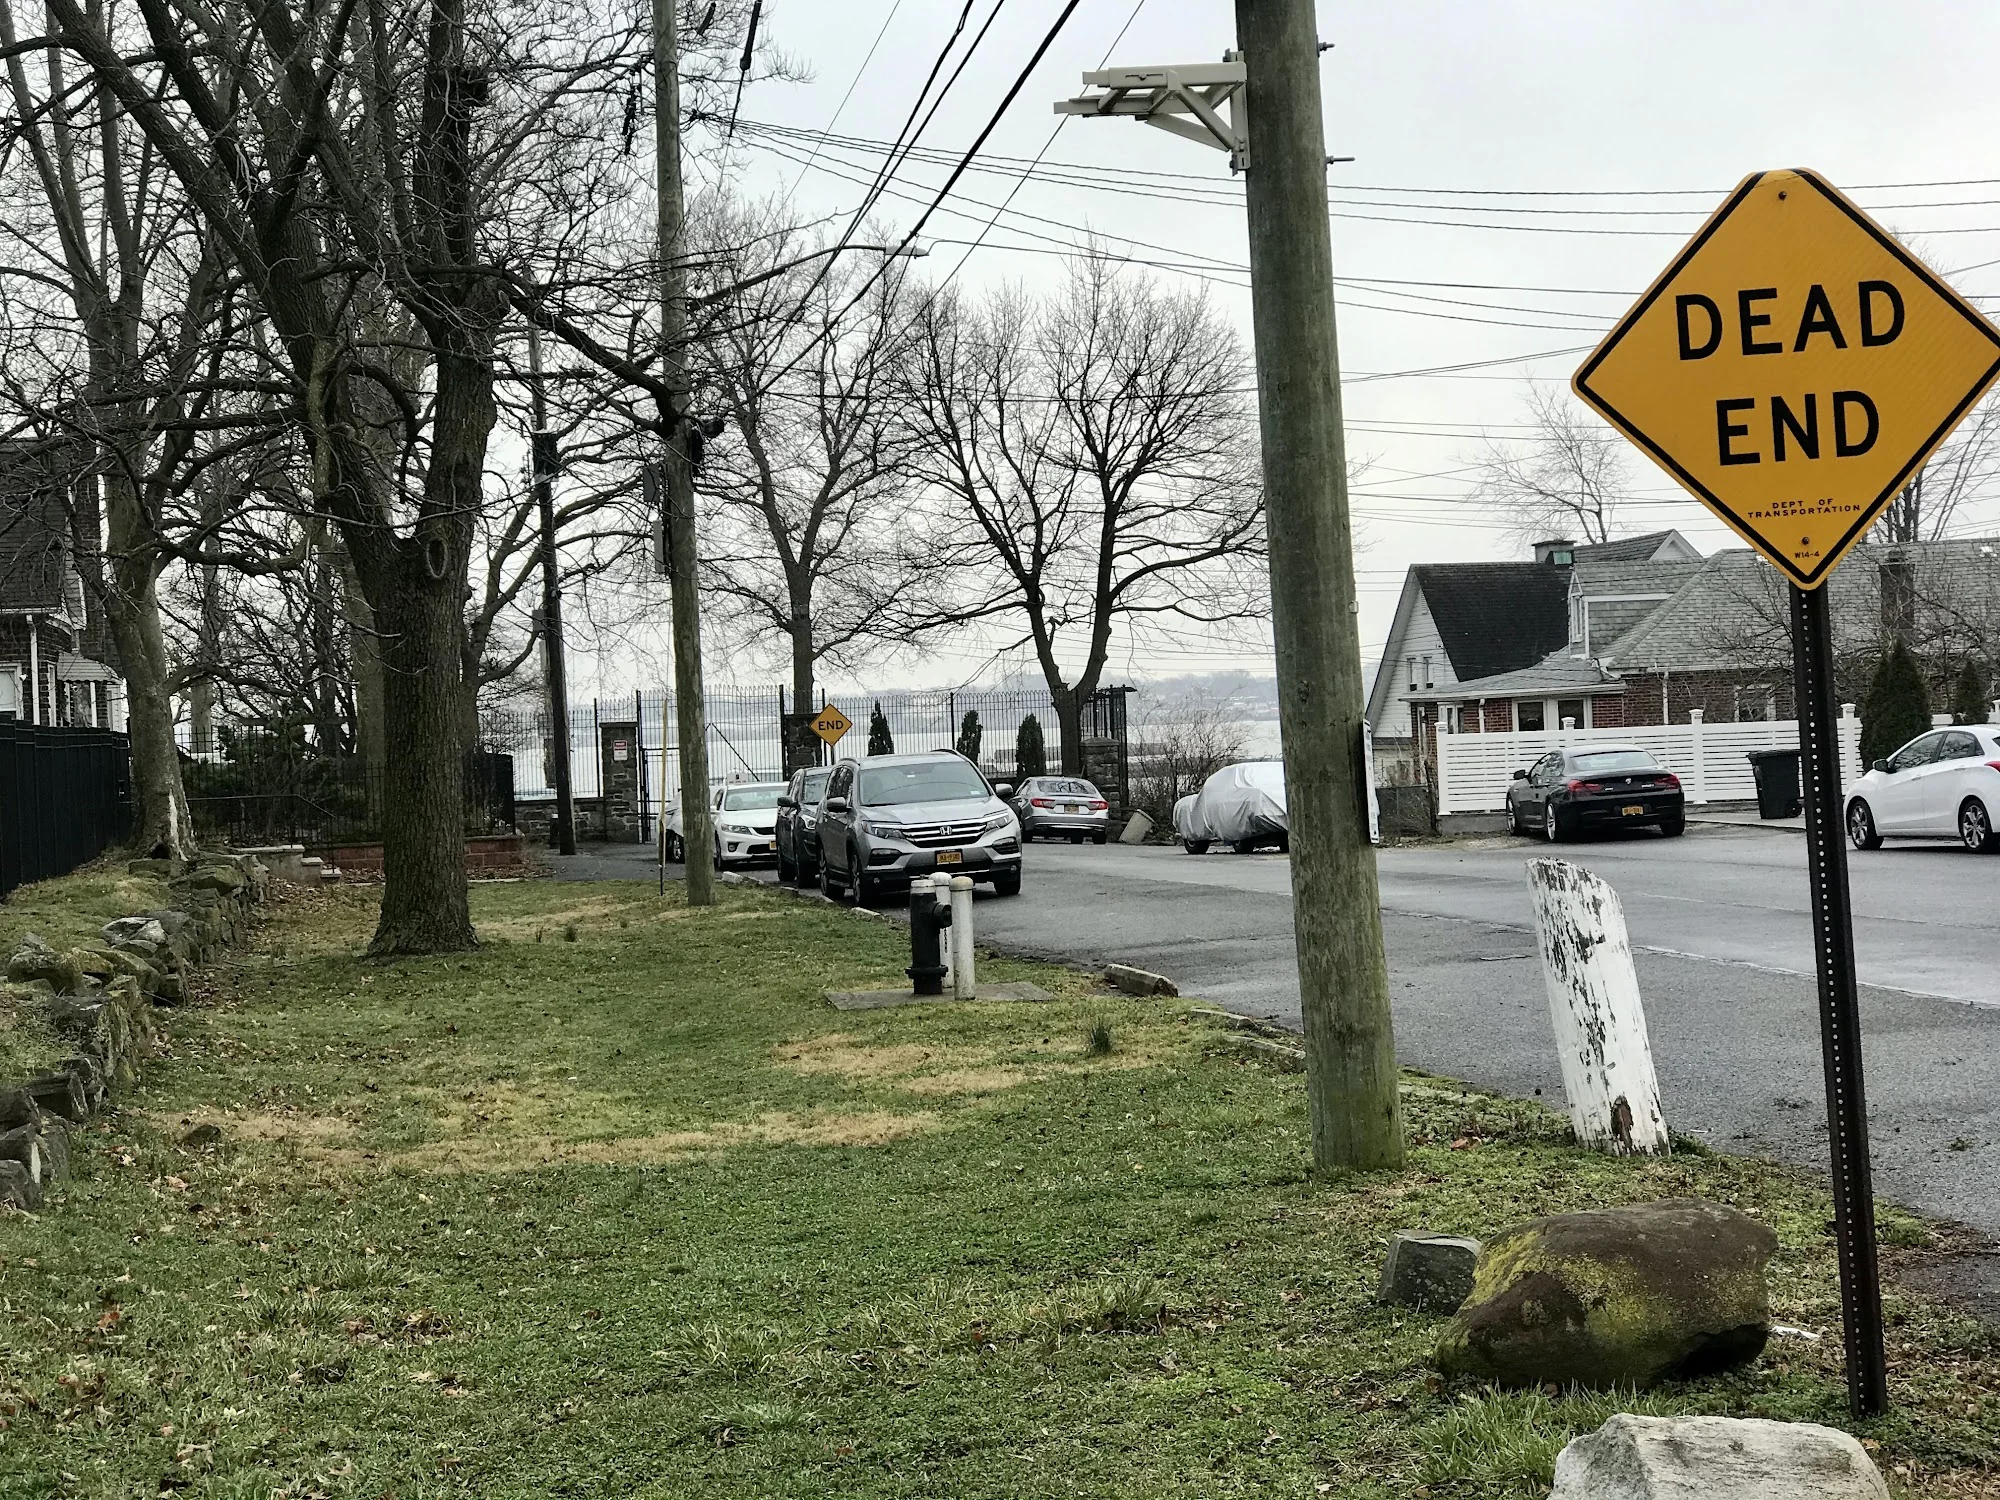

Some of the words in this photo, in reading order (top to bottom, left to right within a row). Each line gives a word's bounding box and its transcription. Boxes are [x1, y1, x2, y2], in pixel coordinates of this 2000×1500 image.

[1675, 280, 1905, 361] DEAD
[1716, 390, 1880, 466] END
[1772, 500, 1804, 509] DEPT
[1818, 498, 1834, 506] OF
[1748, 504, 1860, 519] TRANSPORTATION
[1794, 550, 1820, 559] W14-4
[818, 720, 844, 731] END
